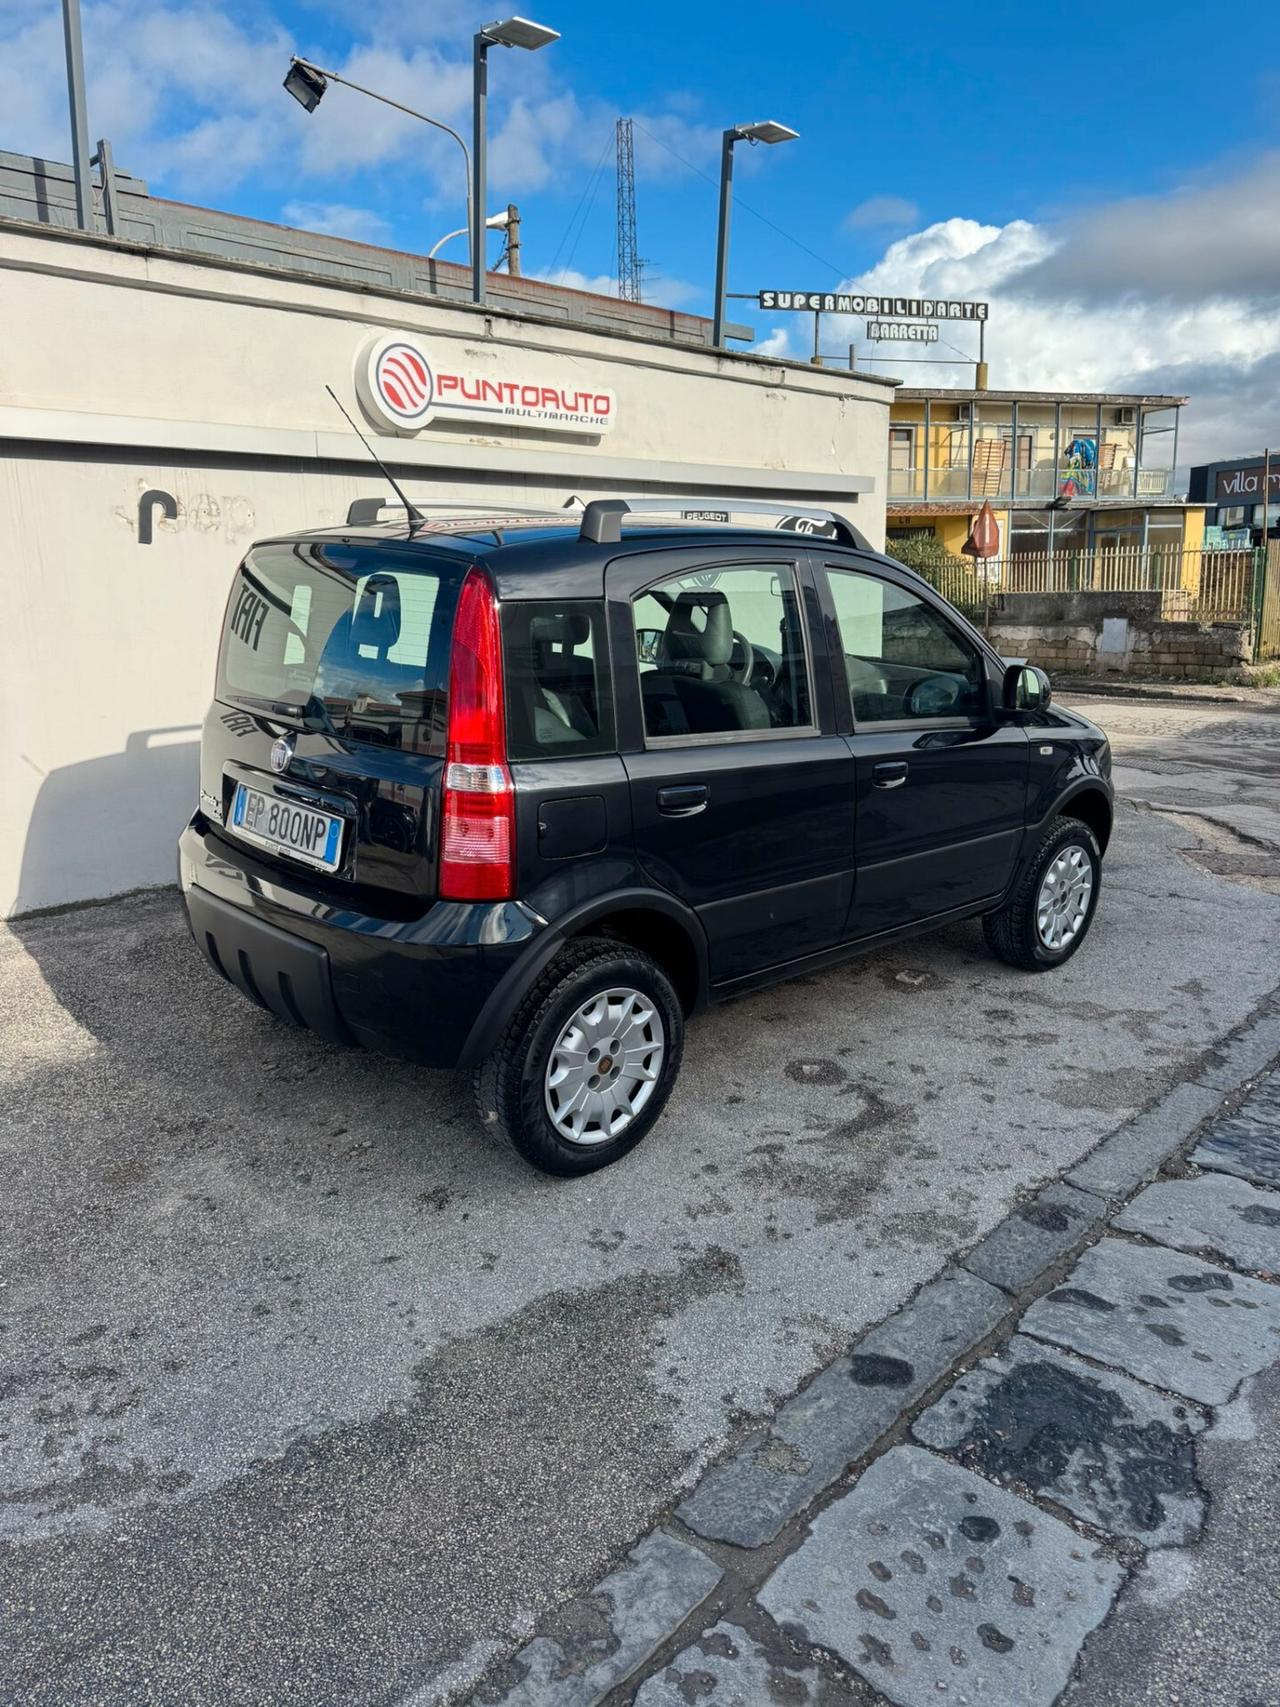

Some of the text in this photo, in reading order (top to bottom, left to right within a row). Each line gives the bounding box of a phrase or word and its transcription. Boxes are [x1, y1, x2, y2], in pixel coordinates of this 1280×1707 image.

[870, 322, 938, 340] BARRETTA
[437, 374, 610, 415] PUNTOAUTO
[504, 407, 609, 425] MULTIMARCHE
[1223, 471, 1258, 494] villa
[686, 511, 728, 522] PEUGEOT
[245, 792, 265, 828] EP
[268, 803, 327, 851] 800NP
